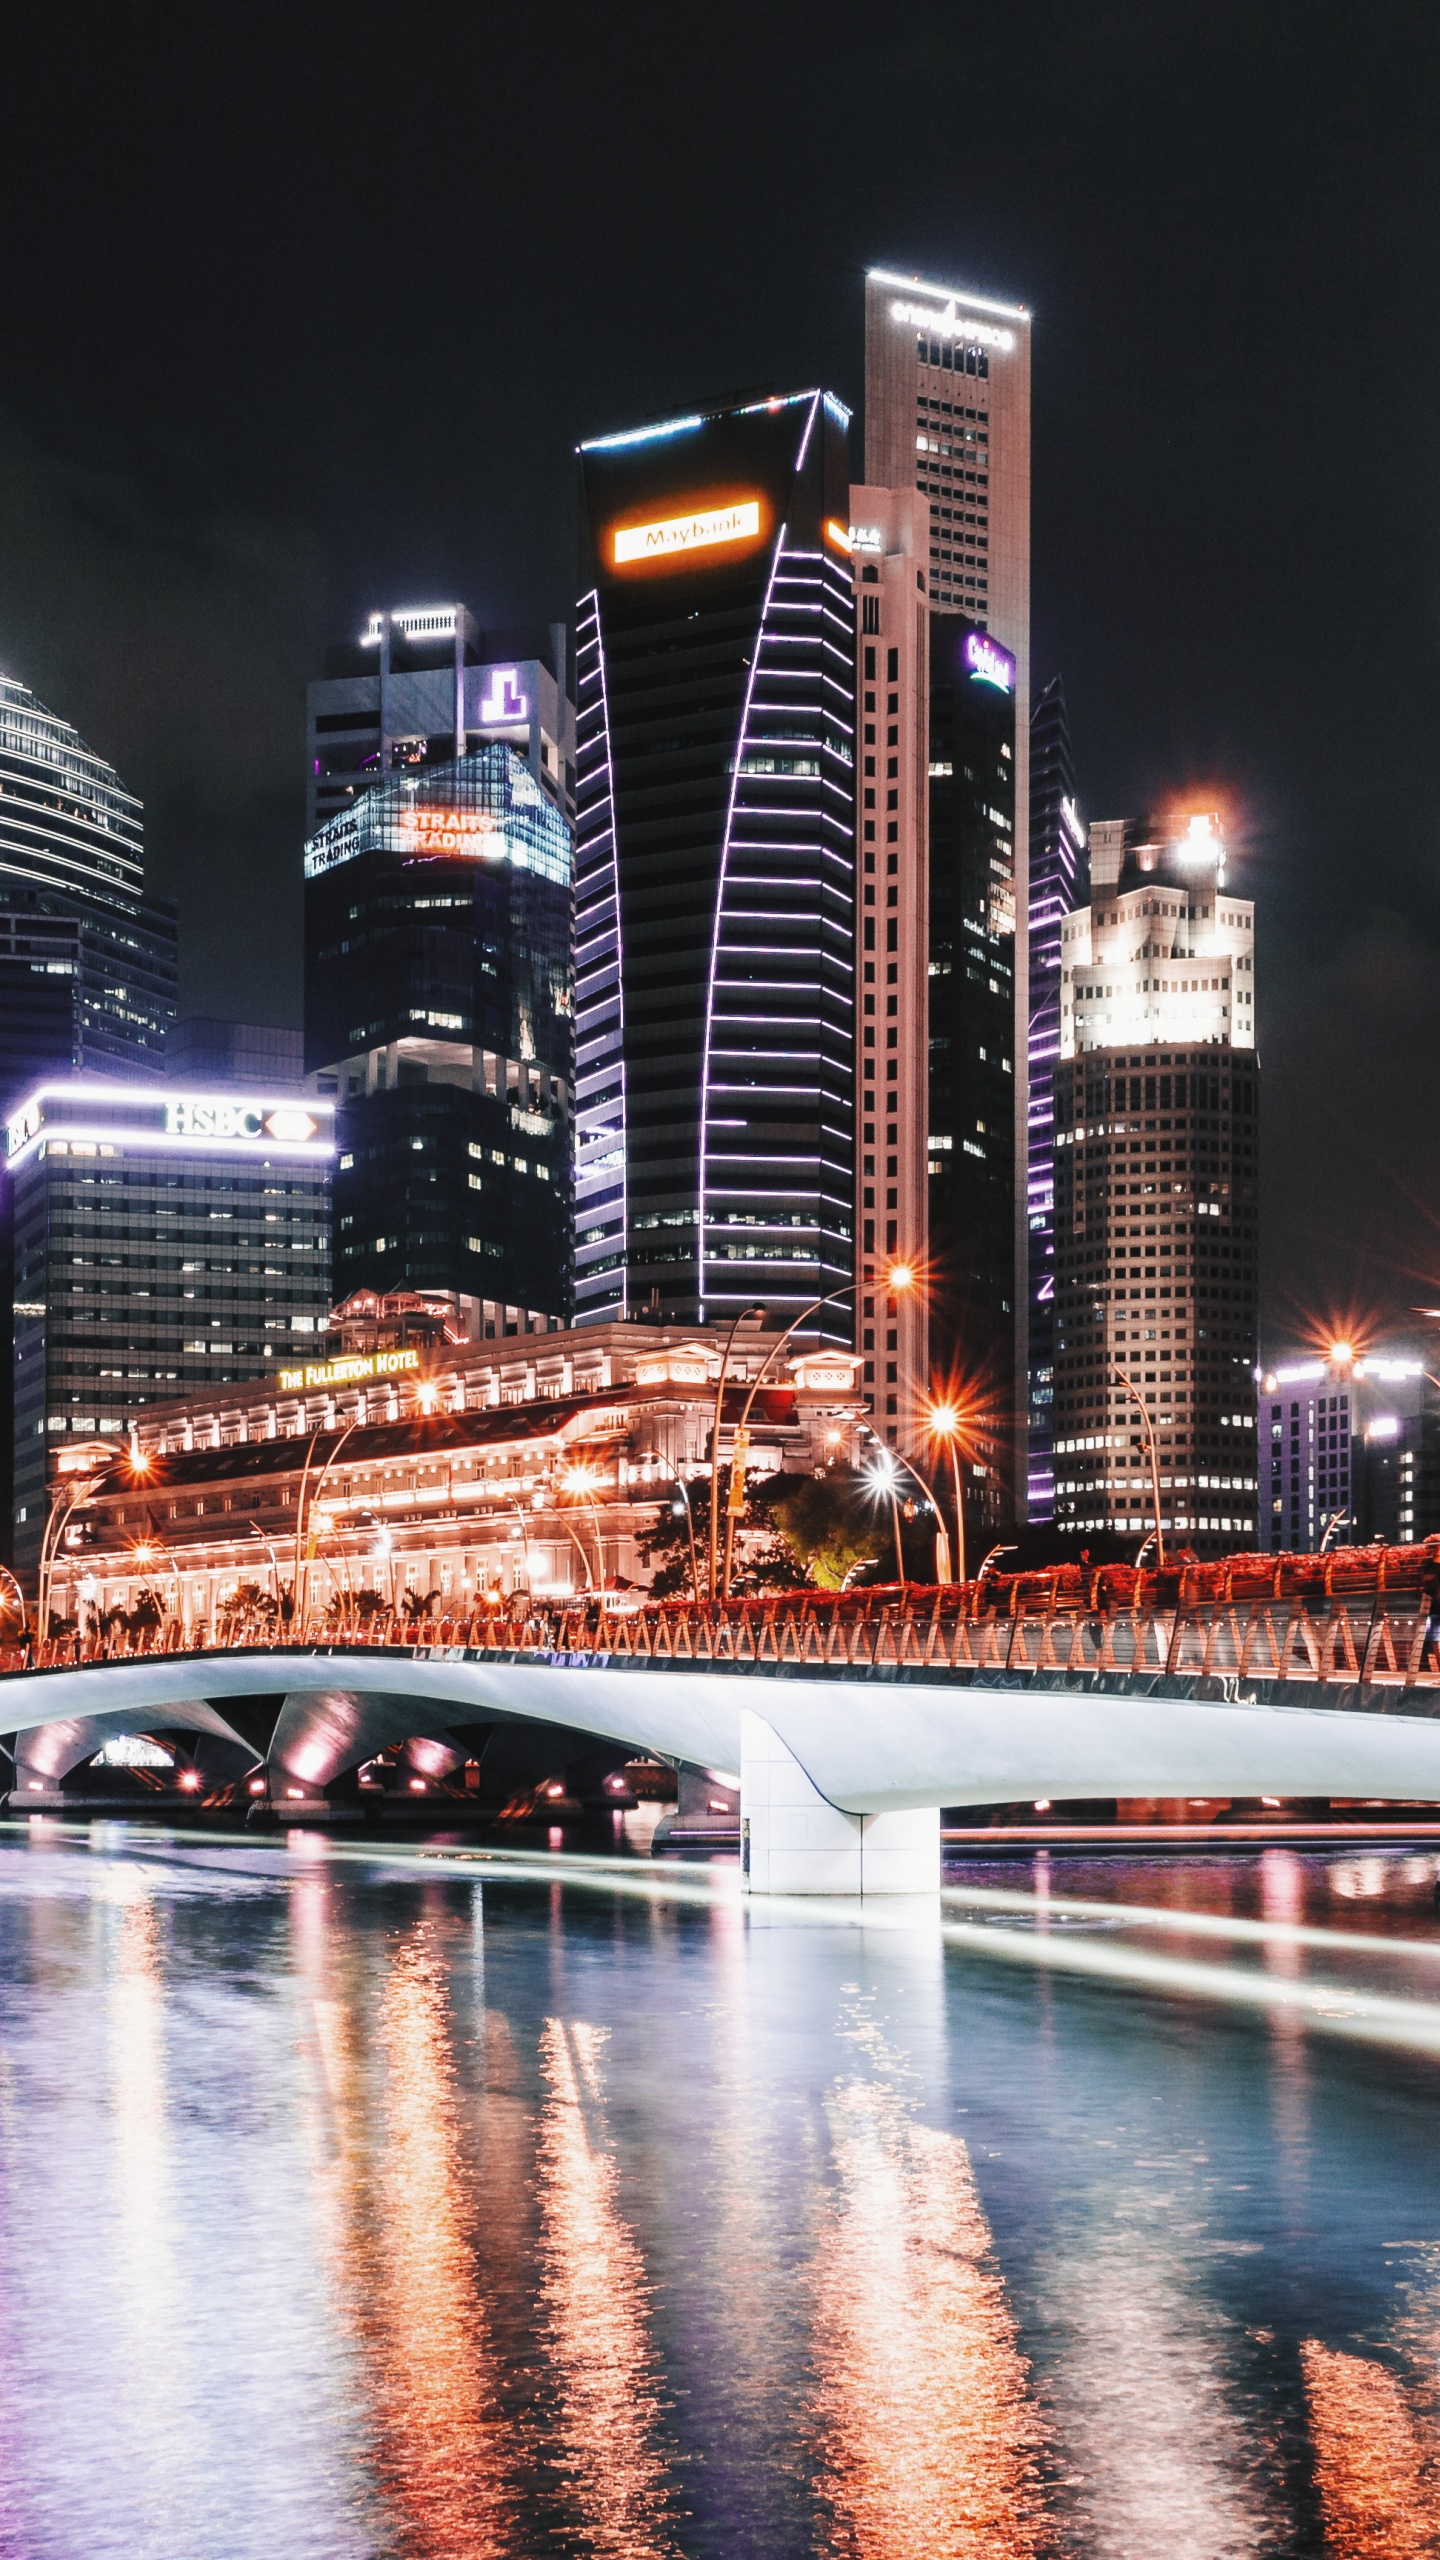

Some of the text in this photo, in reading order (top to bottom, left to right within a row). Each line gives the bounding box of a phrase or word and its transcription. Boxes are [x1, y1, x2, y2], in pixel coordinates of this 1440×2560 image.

[645, 512, 743, 545] Maybank
[312, 818, 358, 852] STRAITS
[404, 811, 493, 832] STRAITS
[312, 836, 360, 870] TRADING
[401, 830, 495, 850] TRADIN
[165, 1102, 262, 1138] HSBC
[280, 1350, 419, 1390] THE FULLERTON HOTEL
